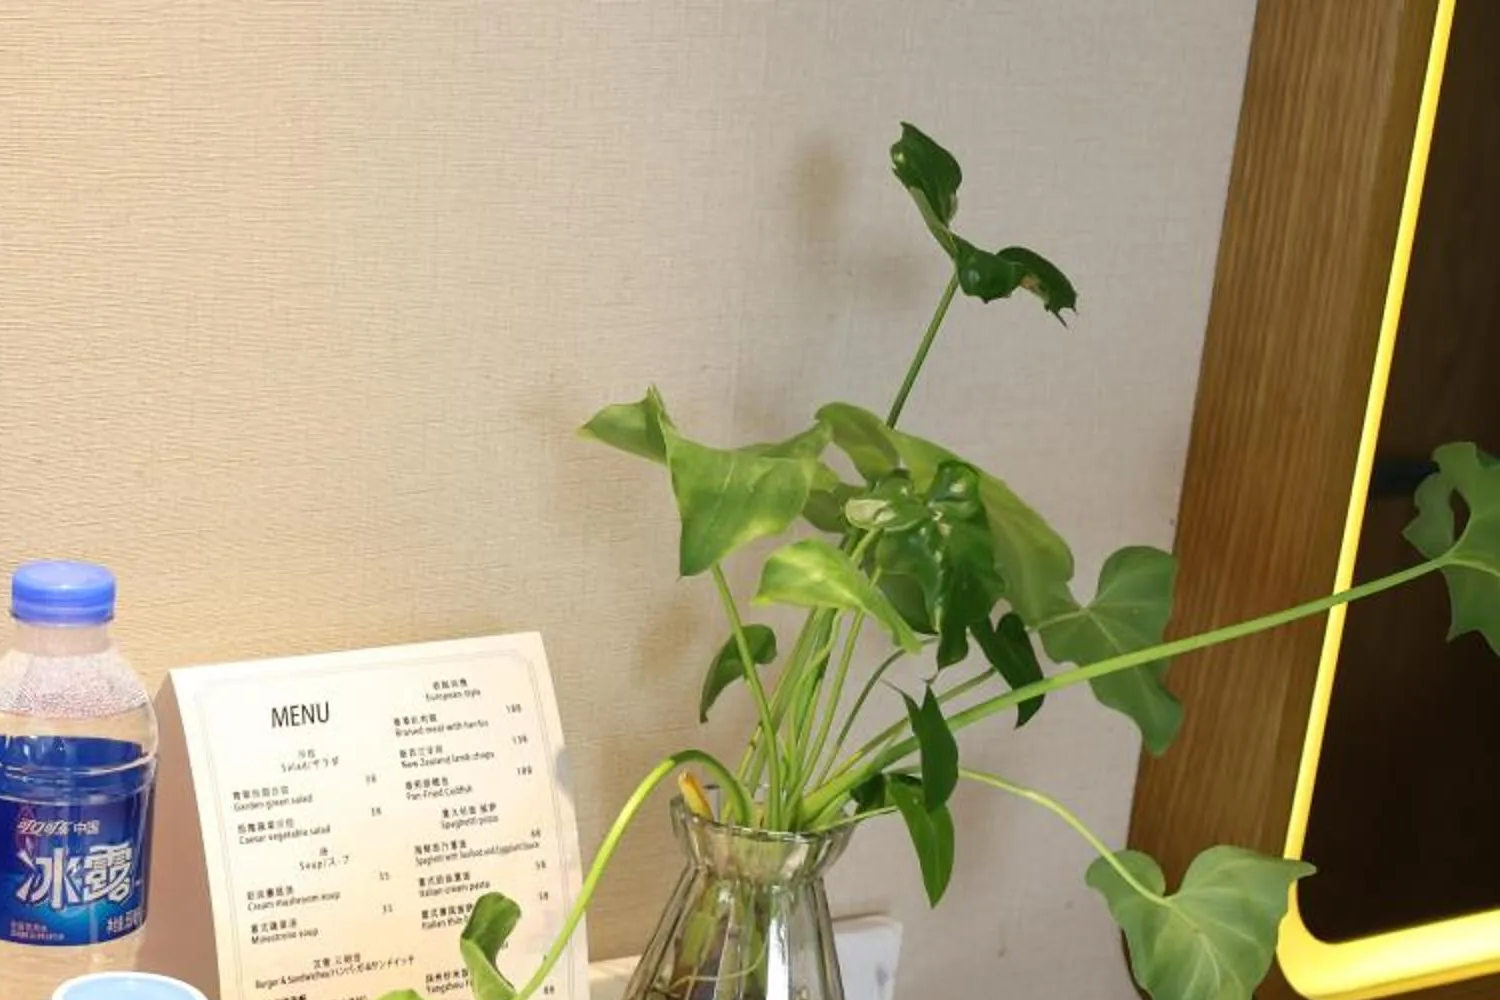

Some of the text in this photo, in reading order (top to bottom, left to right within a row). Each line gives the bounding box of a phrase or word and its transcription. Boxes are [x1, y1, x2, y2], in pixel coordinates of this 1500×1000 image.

[271, 701, 329, 729] MENU
[446, 720, 463, 732] with
[420, 754, 451, 768] Zealand
[451, 752, 470, 763] lamb
[233, 799, 265, 812] Garden
[267, 797, 289, 811] green
[291, 793, 314, 804] salad
[239, 833, 267, 846] Caesar
[267, 828, 309, 843] vegetable
[309, 824, 331, 836] salad
[16, 842, 133, 910] 冰露
[247, 898, 275, 912] Cream
[275, 893, 319, 907] mushroom
